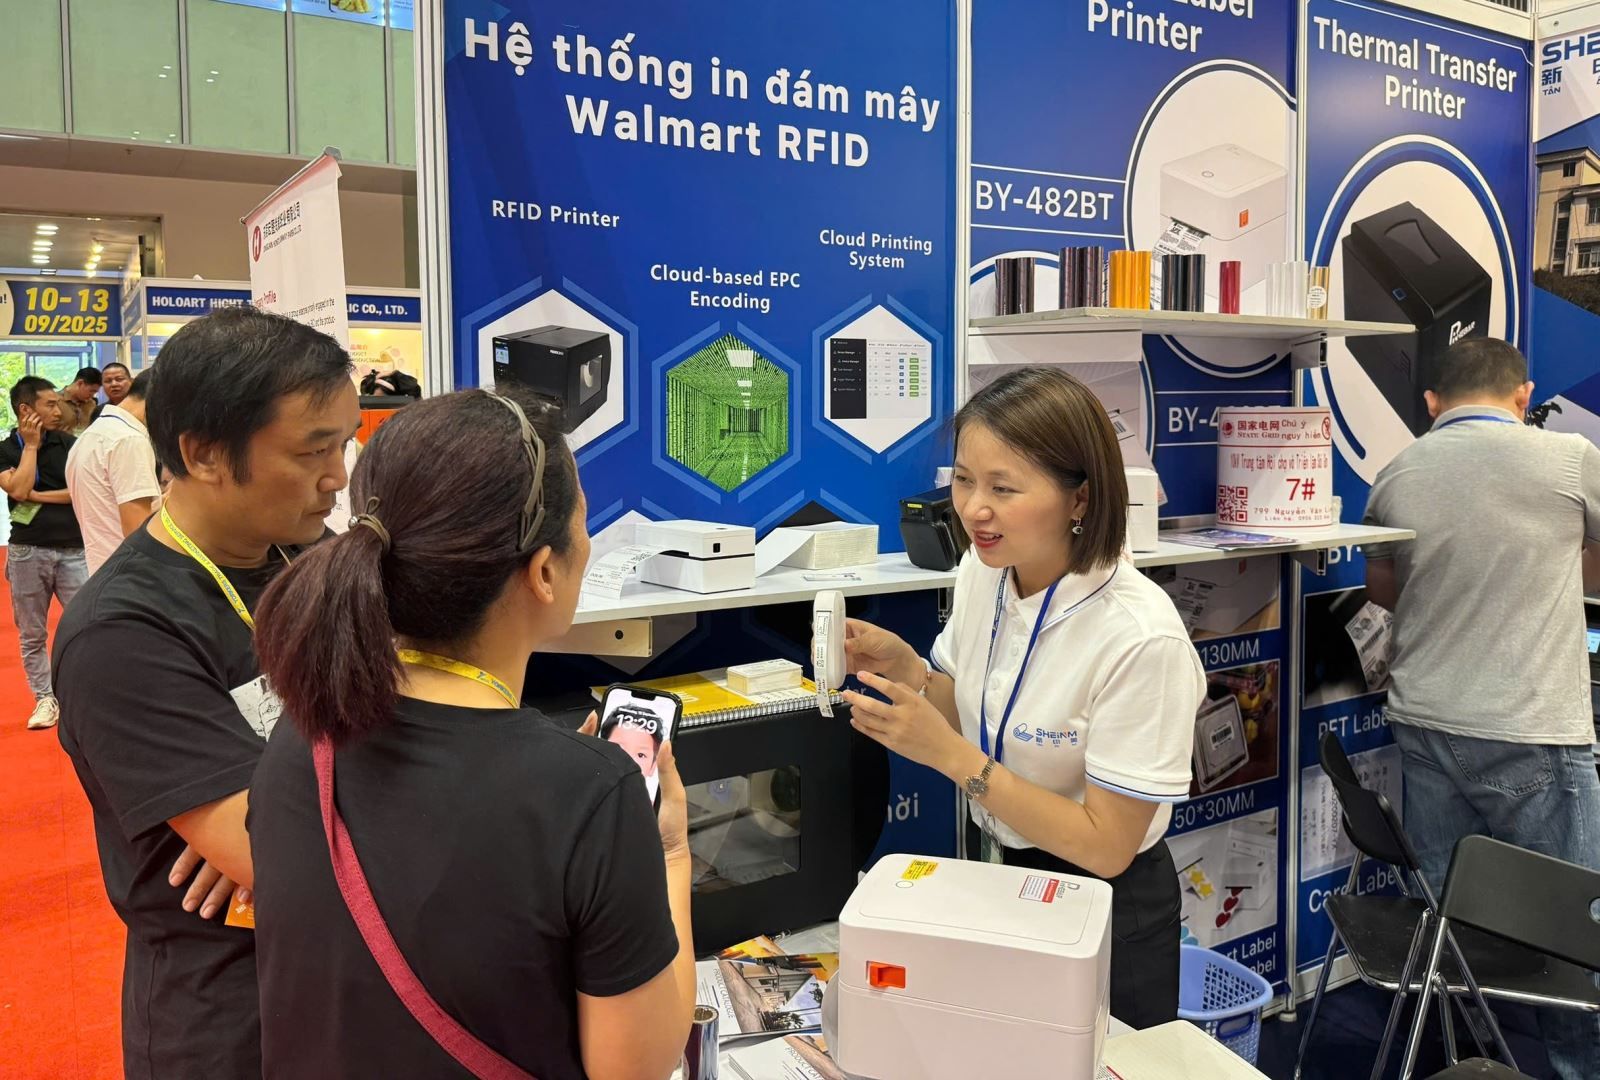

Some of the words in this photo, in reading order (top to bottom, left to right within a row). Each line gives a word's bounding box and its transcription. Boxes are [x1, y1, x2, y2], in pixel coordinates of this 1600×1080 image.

[1088, 0, 1202, 52] Printer
[1313, 16, 1418, 70] Thermal
[1426, 43, 1517, 92] Transfer
[465, 18, 532, 75] Hệ
[553, 33, 692, 99] thống
[712, 57, 748, 99] in
[766, 68, 849, 113] đám
[866, 86, 940, 132] mây
[1385, 75, 1465, 119] Printer
[566, 94, 761, 155] Walmart
[779, 125, 869, 167] RFID
[976, 179, 1114, 220] BY-482BT
[492, 200, 542, 220] RFID
[551, 206, 620, 227] Printer
[820, 230, 865, 247] Cloud
[871, 234, 933, 254] Printing
[849, 252, 905, 270] System
[650, 264, 763, 287] Cloud-based
[770, 271, 800, 288] EPC
[152, 296, 206, 308] HOLOART
[385, 305, 408, 315] LTD.
[690, 291, 770, 313] Encoding
[24, 314, 108, 333] 09/2025
[1238, 420, 1279, 430] 国家电网
[1286, 478, 1315, 501] 7#
[1198, 638, 1259, 666] 130MM
[617, 714, 657, 735] 13:29
[1242, 931, 1276, 959] Label
